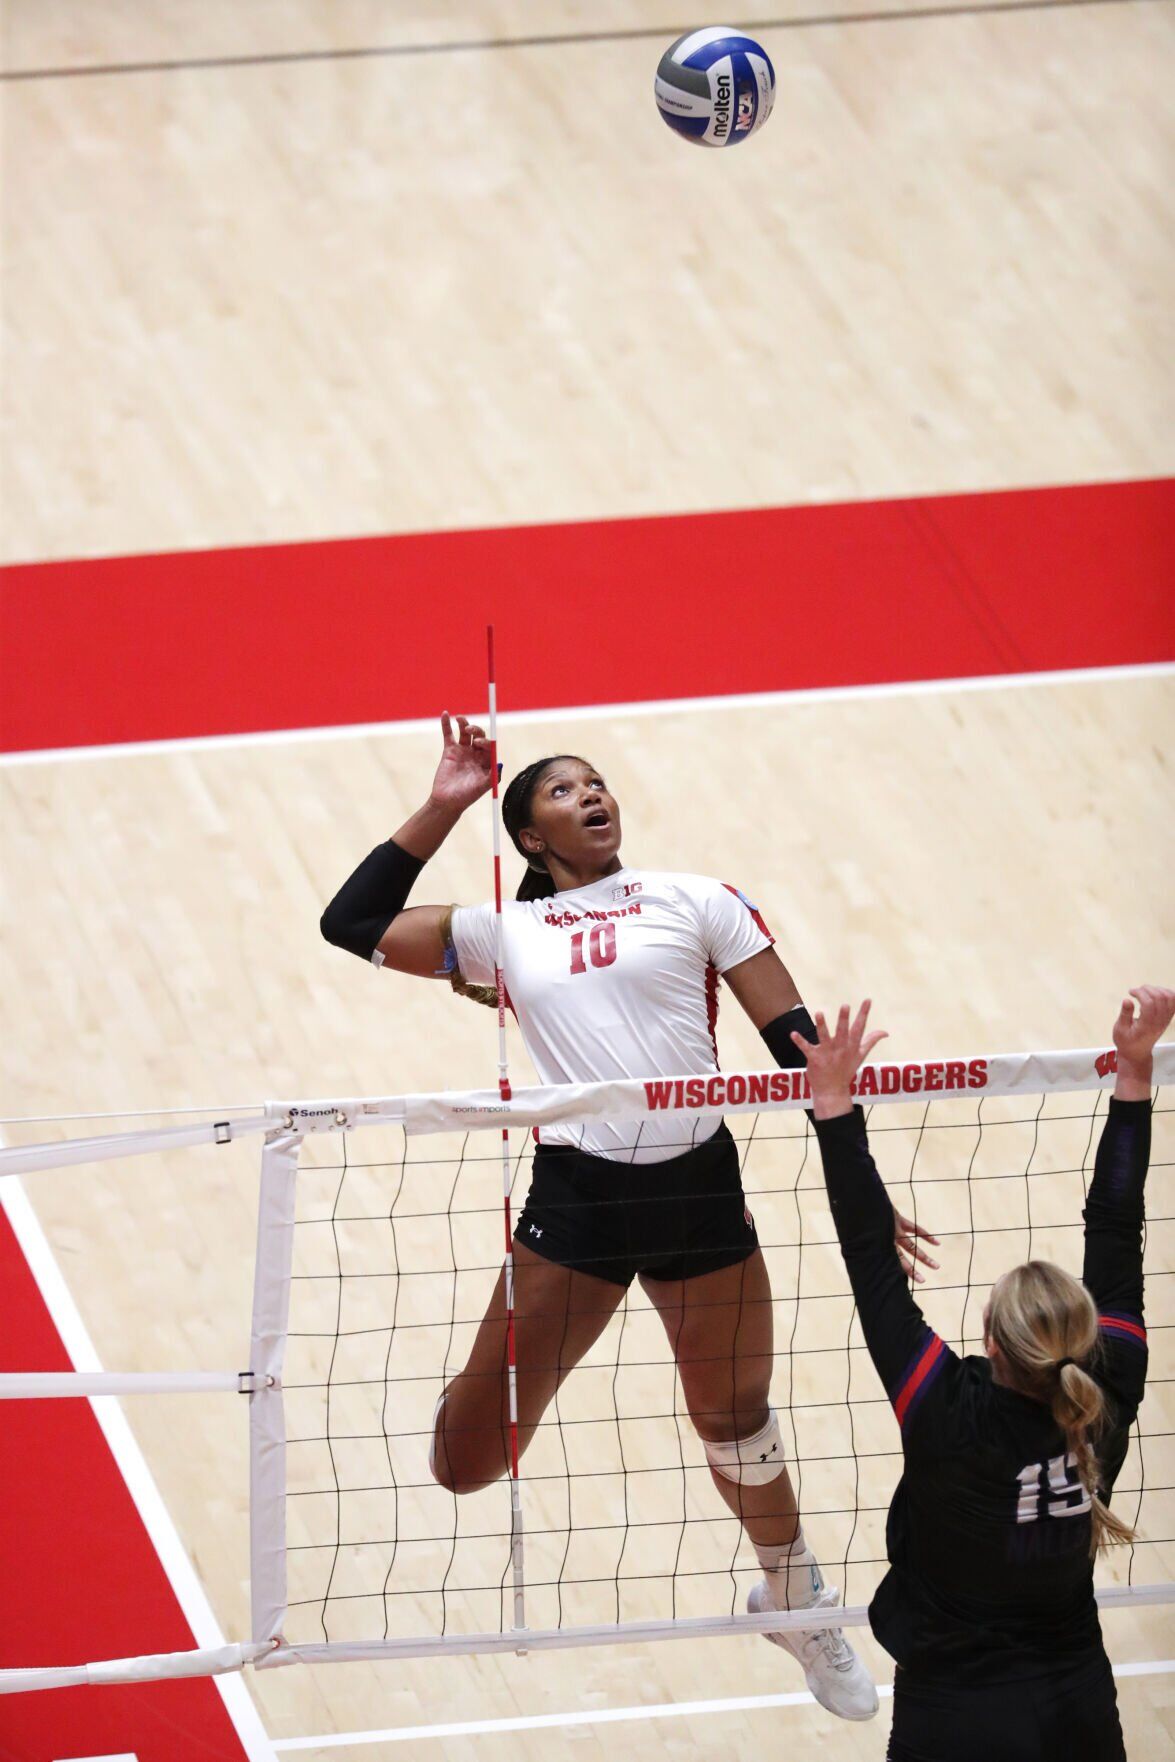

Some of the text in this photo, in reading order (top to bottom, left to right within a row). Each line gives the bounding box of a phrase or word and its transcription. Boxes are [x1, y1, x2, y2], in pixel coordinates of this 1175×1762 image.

[714, 75, 731, 137] molten
[570, 922, 617, 975] 10
[300, 1107, 338, 1117] Senoh
[1016, 1446, 1096, 1524] 15
